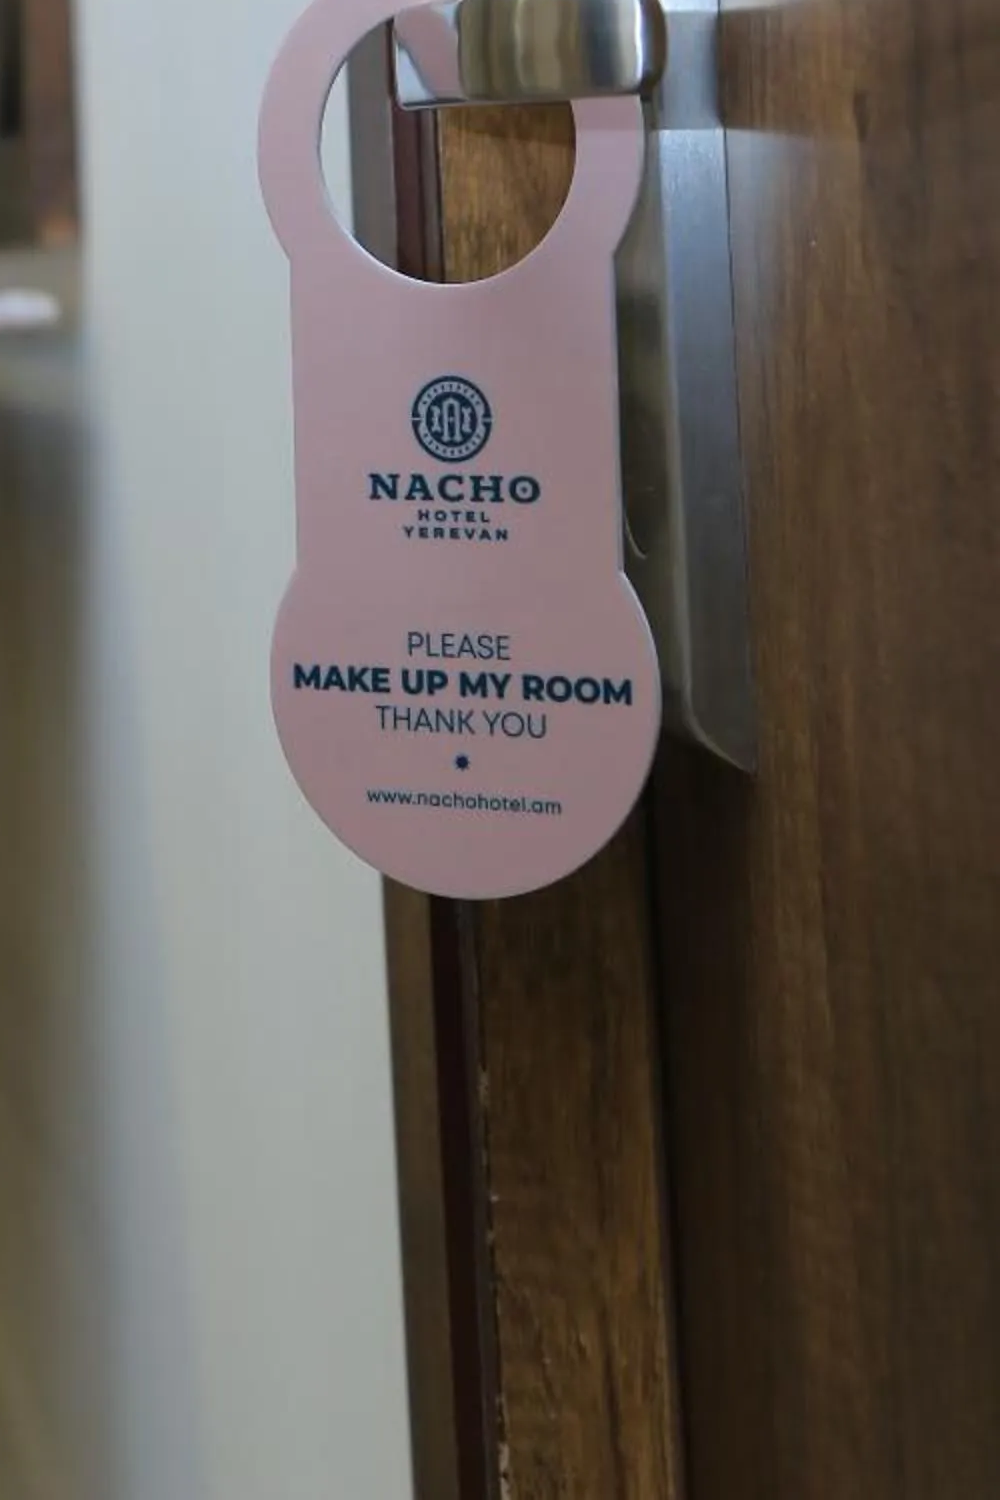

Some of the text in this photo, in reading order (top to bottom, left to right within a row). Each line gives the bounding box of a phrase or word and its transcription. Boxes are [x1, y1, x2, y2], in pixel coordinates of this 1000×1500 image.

[369, 473, 541, 504] NACHO
[418, 509, 490, 523] HOTEL
[404, 526, 509, 541] YEREVAN
[407, 631, 512, 661] PLEASE
[293, 663, 633, 706] MAKE UP MY ROOM
[376, 705, 547, 740] THANK YOU
[366, 788, 562, 816] www.nachohotel.am
